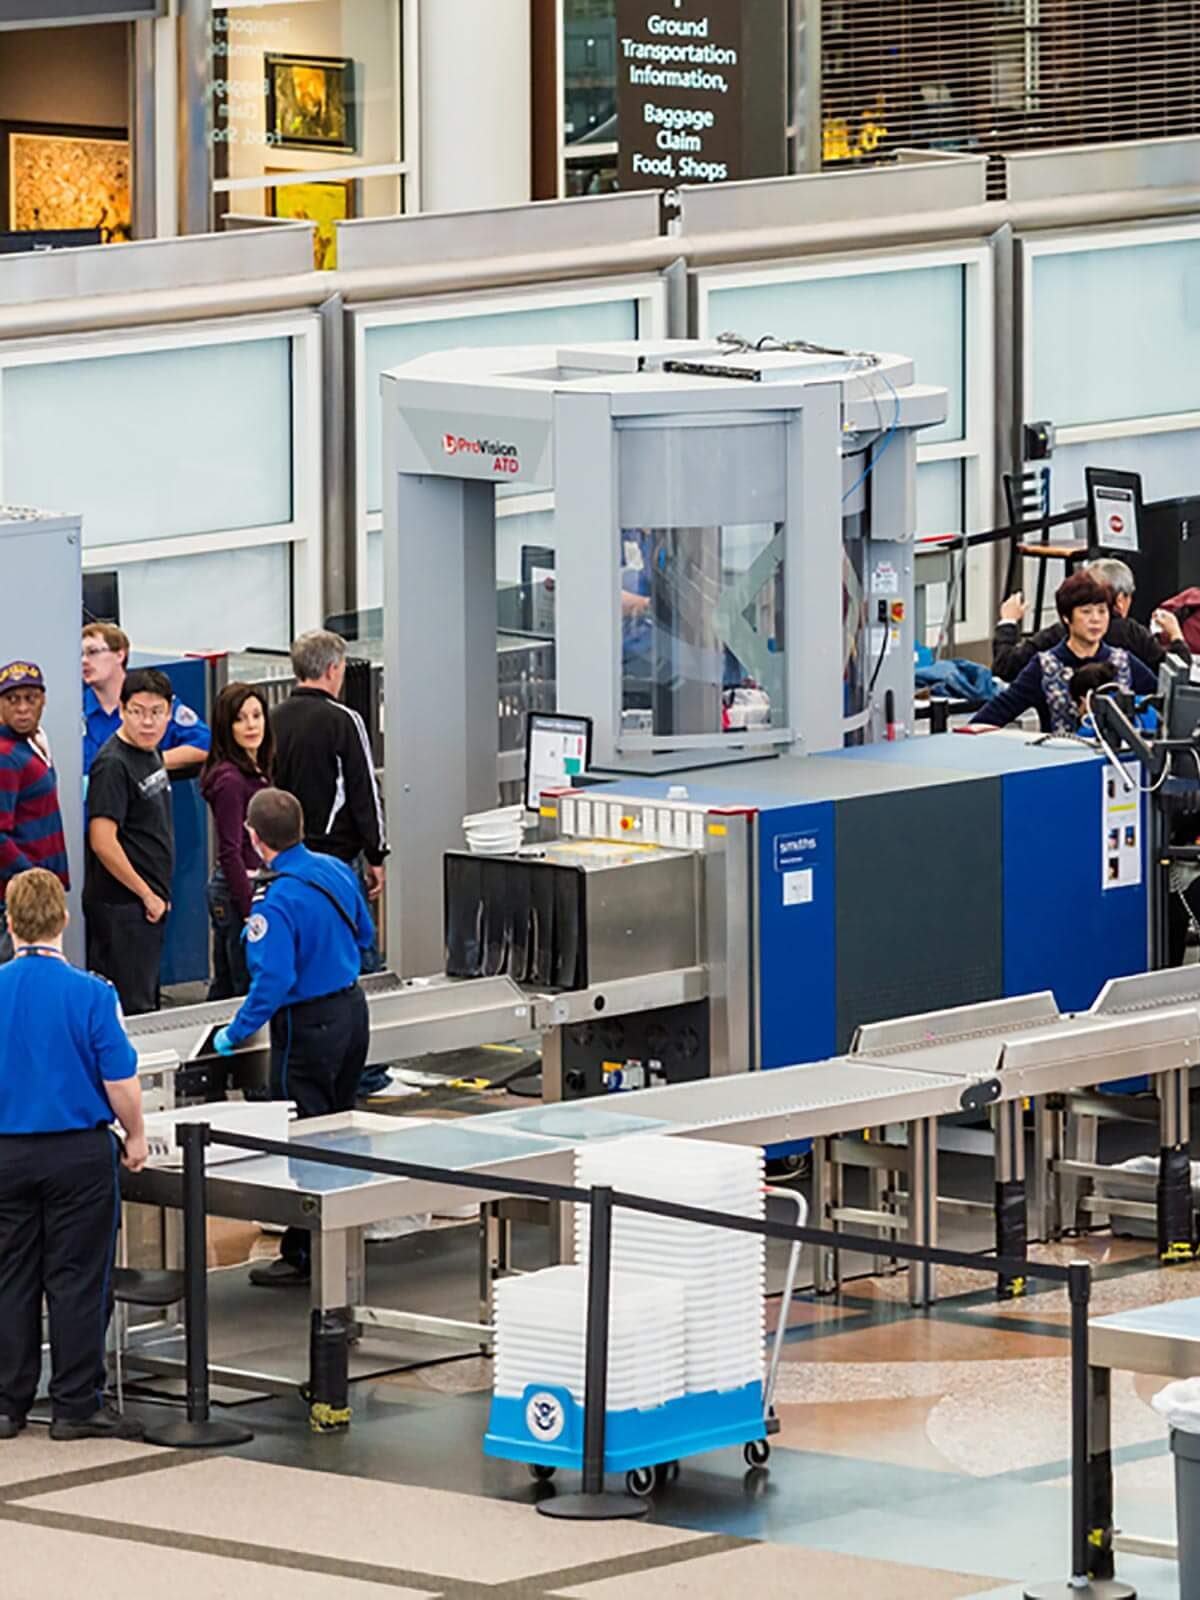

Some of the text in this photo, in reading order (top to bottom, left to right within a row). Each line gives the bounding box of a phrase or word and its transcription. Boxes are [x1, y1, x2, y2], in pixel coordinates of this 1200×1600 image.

[647, 15, 708, 37] Ground
[621, 38, 737, 64] Transportation
[629, 65, 728, 92] Information,
[643, 104, 714, 130] Baggage
[656, 131, 701, 151] Claim
[632, 154, 727, 182] Food, Shops
[458, 437, 518, 456] ProVision
